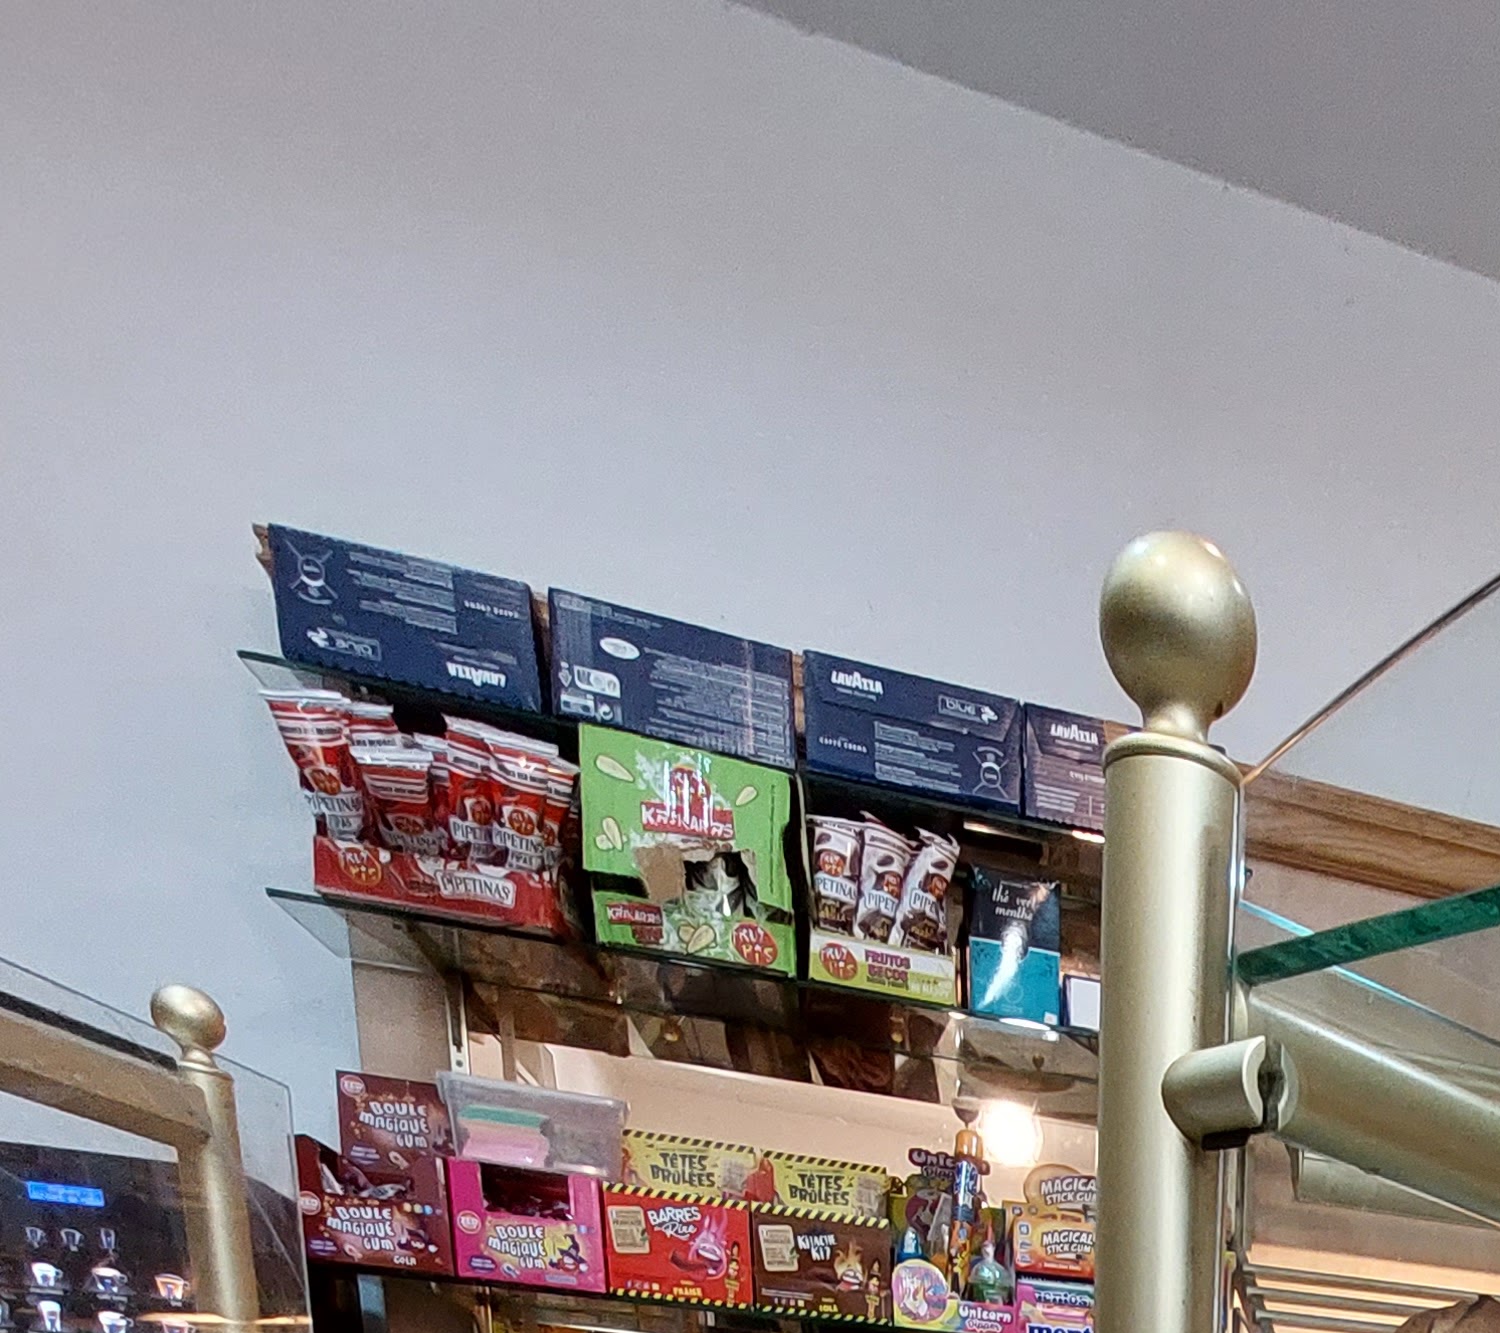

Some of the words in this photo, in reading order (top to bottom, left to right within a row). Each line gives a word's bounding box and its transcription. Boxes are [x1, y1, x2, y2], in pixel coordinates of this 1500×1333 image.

[446, 661, 506, 689] LAVAZZA
[830, 670, 884, 695] LAVAZZA
[1050, 723, 1099, 746] LAVAZZA
[439, 874, 512, 901] PIPETINAS
[865, 949, 911, 969] FRUTOS
[868, 964, 909, 982] SECOS
[369, 1101, 428, 1117] BOULE
[358, 1111, 430, 1135] MAGIQUE
[396, 1136, 429, 1149] GUM
[658, 1152, 709, 1171] TÊTES
[797, 1173, 845, 1191] TÊTES
[1041, 1176, 1097, 1195] MAGICA
[788, 1184, 851, 1206] BRÛLÉES
[1045, 1191, 1074, 1205] STICK
[335, 1205, 393, 1221] BOULE
[647, 1206, 702, 1225] BARRES
[326, 1216, 396, 1238] MAGIQUE
[495, 1224, 545, 1240] BOULE
[363, 1237, 396, 1252] GUM
[487, 1235, 548, 1258] MAGIQUE
[1042, 1230, 1095, 1247] MAGICAL
[1045, 1243, 1070, 1255] STICK
[1070, 1243, 1092, 1255] GUM
[519, 1257, 546, 1270] GUM
[957, 1303, 1013, 1324] Unicorn
